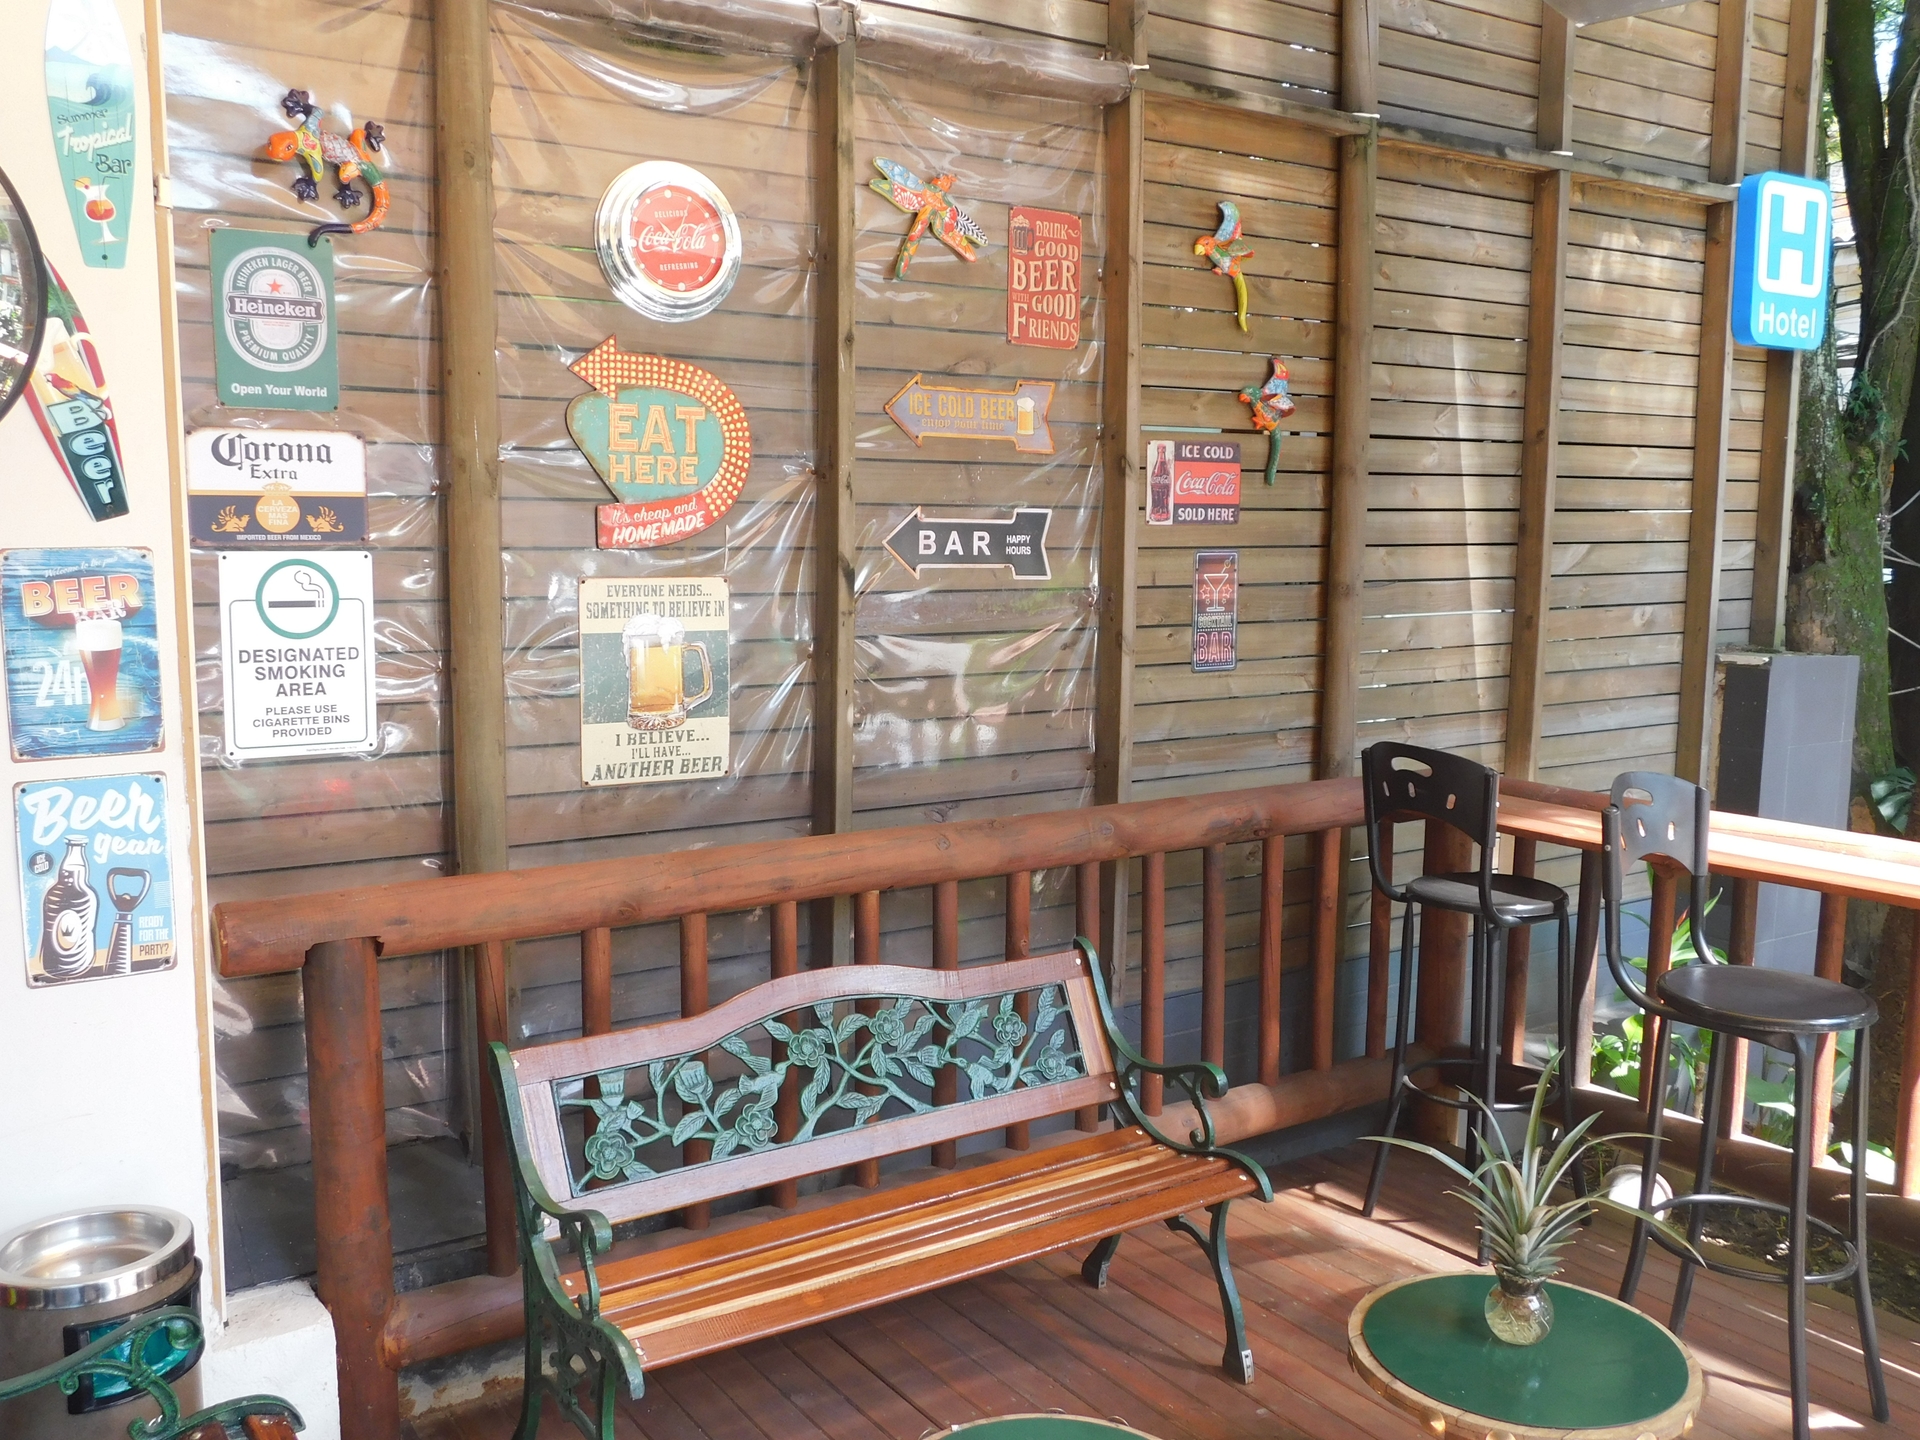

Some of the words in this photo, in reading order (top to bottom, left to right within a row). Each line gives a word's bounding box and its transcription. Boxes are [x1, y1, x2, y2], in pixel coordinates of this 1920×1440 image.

[56, 108, 108, 125] Summer
[57, 113, 132, 162] Tropical
[96, 154, 132, 174] Bar
[654, 209, 689, 218] DELICIOUS
[1036, 220, 1068, 240] DRINK
[1034, 240, 1079, 262] GOOD
[236, 257, 269, 288] HEINEKEN
[272, 257, 300, 274] LAGER
[297, 271, 313, 292] BEER
[659, 262, 699, 271] REFRESHING
[1012, 257, 1078, 293] BEER
[1012, 292, 1030, 303] WITH
[234, 297, 317, 318] Heineken
[1032, 293, 1077, 320] GOOD
[1012, 302, 1078, 342] FRIENDS
[1758, 301, 1816, 339] Hotel
[239, 330, 278, 361] PREMIUM
[282, 335, 315, 361] QUALITY
[231, 383, 262, 396] Open
[265, 384, 291, 396] Your
[295, 385, 327, 397] World
[909, 392, 932, 416] ICE
[938, 394, 974, 419] COLD
[980, 397, 1016, 421] BEER
[608, 402, 706, 454] EAT
[922, 418, 950, 429] enjoy
[211, 433, 333, 471] Corona
[1182, 445, 1200, 457] ICE
[1204, 446, 1234, 459] COLD
[250, 464, 298, 480] Extra
[609, 454, 699, 485] HERE
[257, 505, 298, 513] CERVEZA
[611, 507, 630, 524] It's
[633, 506, 671, 522] cheap
[673, 499, 698, 515] and
[1178, 507, 1206, 520] SOLD
[1208, 508, 1235, 521] HERE
[269, 518, 289, 526] FINA
[612, 510, 706, 544] HOMEMADE
[918, 530, 991, 556] BAR
[1006, 535, 1031, 544] HAPPY
[1006, 546, 1031, 555] HOURS
[44, 565, 79, 577] Welcome
[80, 561, 88, 569] to
[21, 574, 143, 618] BEER
[607, 584, 665, 598] EVERYONE
[668, 584, 712, 597] NEEDS...
[72, 599, 127, 622] BAR
[586, 601, 649, 619] SOMETHING
[652, 600, 666, 618] TO
[669, 600, 711, 618] BELIEVE
[714, 600, 725, 617] IN
[1198, 615, 1233, 628] COCKTAIL
[238, 647, 360, 664] DESIGNATED
[1197, 631, 1232, 663] BAR
[254, 664, 346, 681] SMOKING
[275, 682, 327, 697] AREA
[265, 705, 311, 716] PLEASE
[314, 704, 338, 714] USE
[252, 716, 320, 728] CIGARETTE
[323, 714, 350, 724] BINS
[272, 727, 332, 738] PROVIDED
[615, 733, 621, 746] I
[627, 729, 710, 746] BELIEVE...
[631, 746, 649, 759] I'LL
[653, 745, 691, 758] HAVE...
[591, 757, 674, 782] ANOTHER
[679, 756, 723, 775] BEER
[23, 781, 162, 846] Beer
[94, 832, 164, 864] gear
[36, 853, 46, 864] ICE
[34, 861, 49, 874] COLD
[139, 915, 164, 928] READY
[139, 929, 154, 942] FOR
[155, 928, 169, 941] THE
[139, 943, 170, 956] PARTY?
